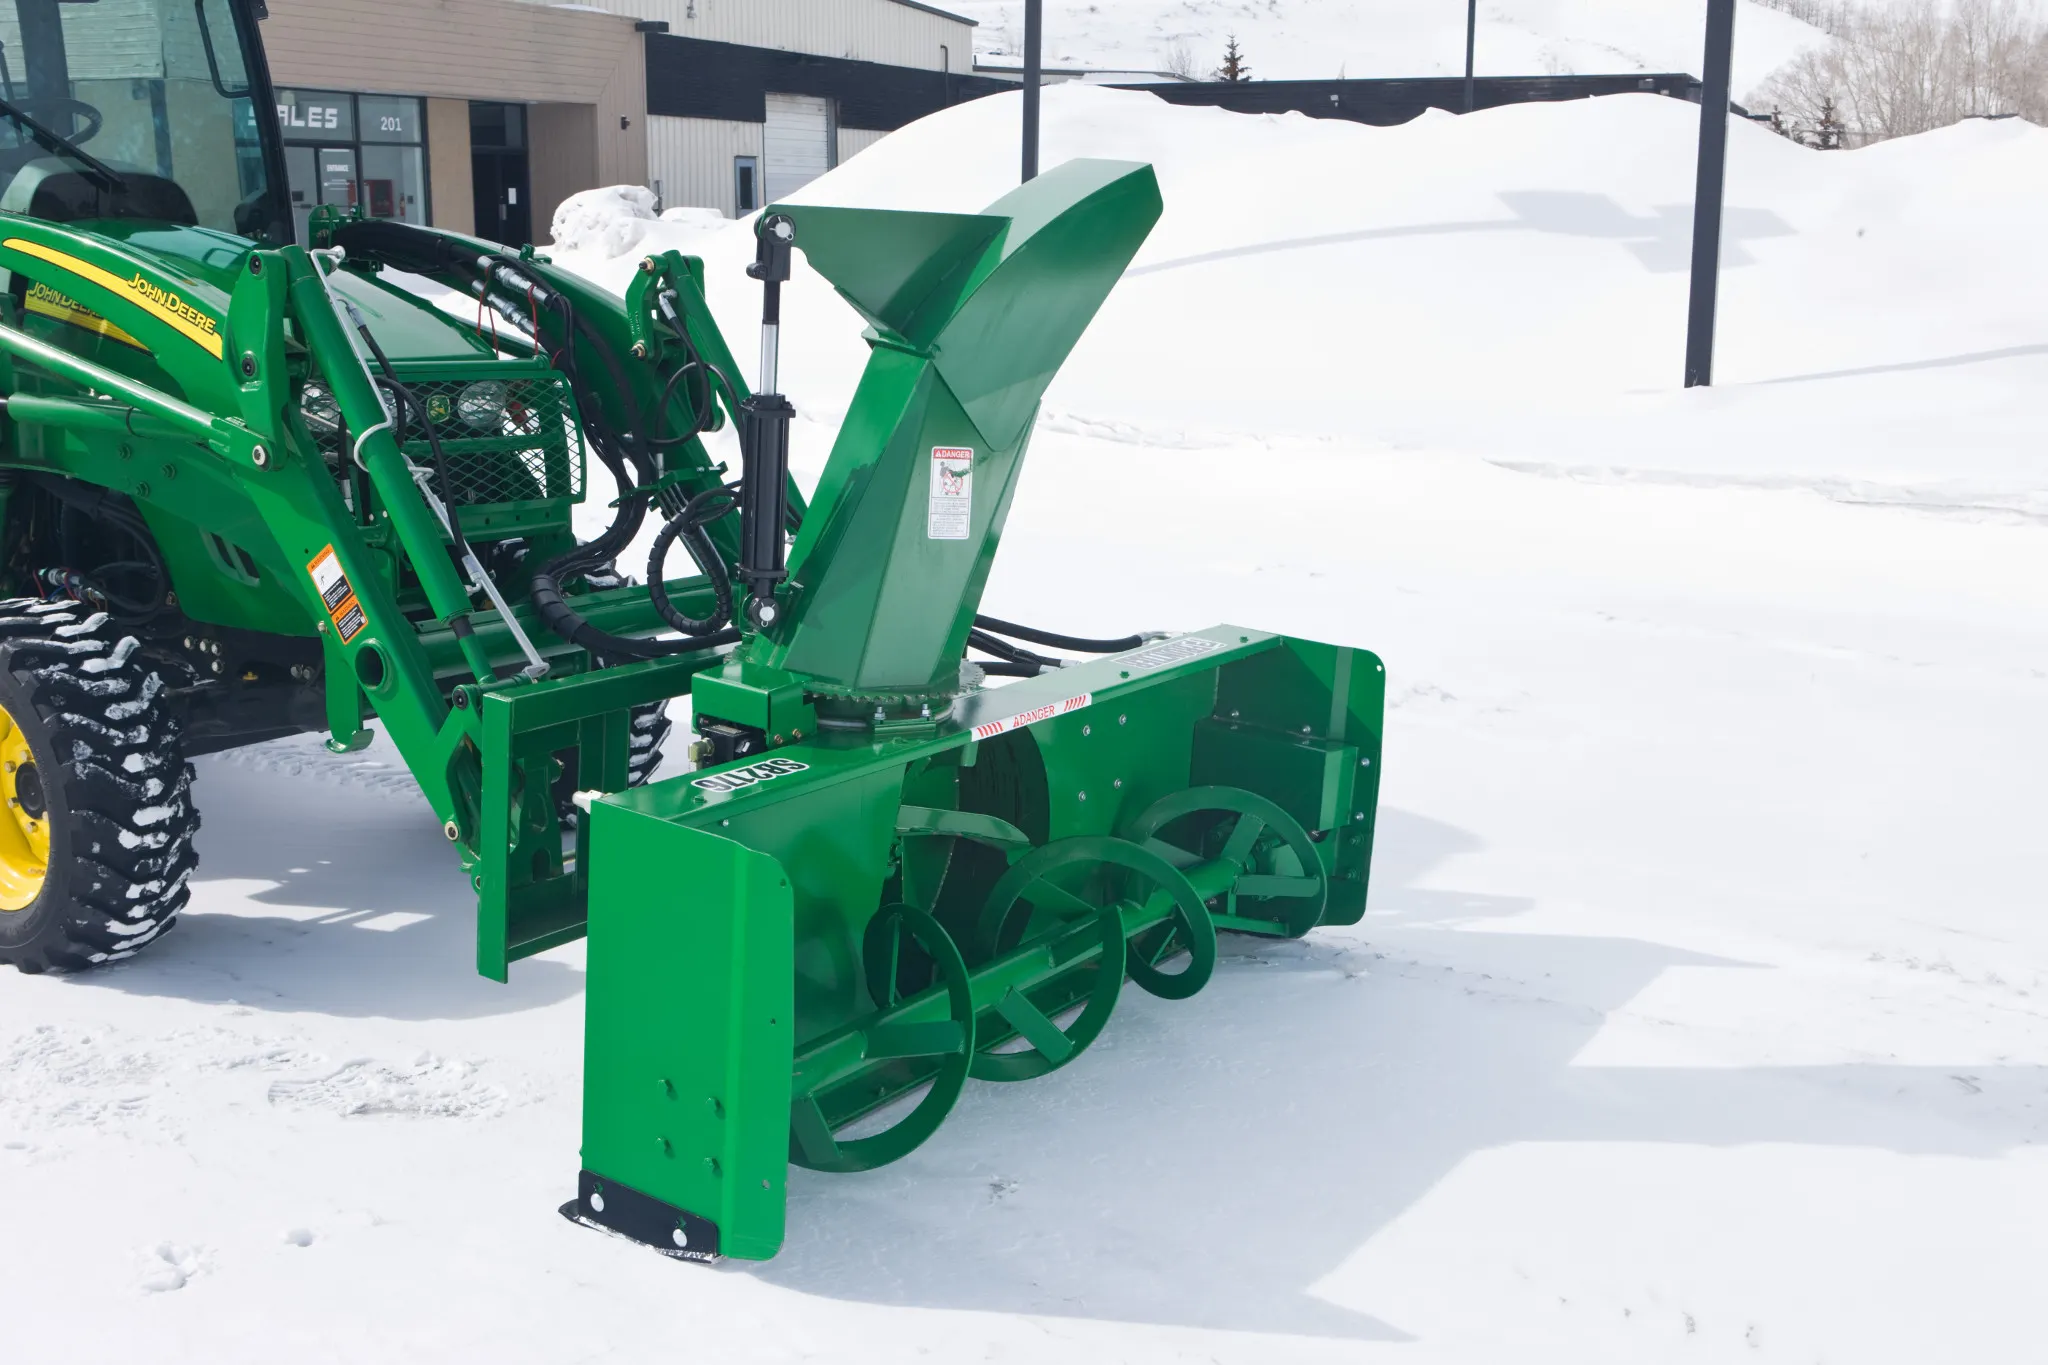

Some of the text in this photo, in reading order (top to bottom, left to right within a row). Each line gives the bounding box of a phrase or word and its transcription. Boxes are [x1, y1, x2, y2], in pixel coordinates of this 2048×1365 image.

[380, 116, 402, 131] 201
[27, 281, 62, 306] JOHN
[127, 272, 217, 335] JOHN DEERE
[941, 450, 970, 458] DANGER
[1019, 705, 1055, 726] DANGER
[693, 759, 808, 791] SB2176
